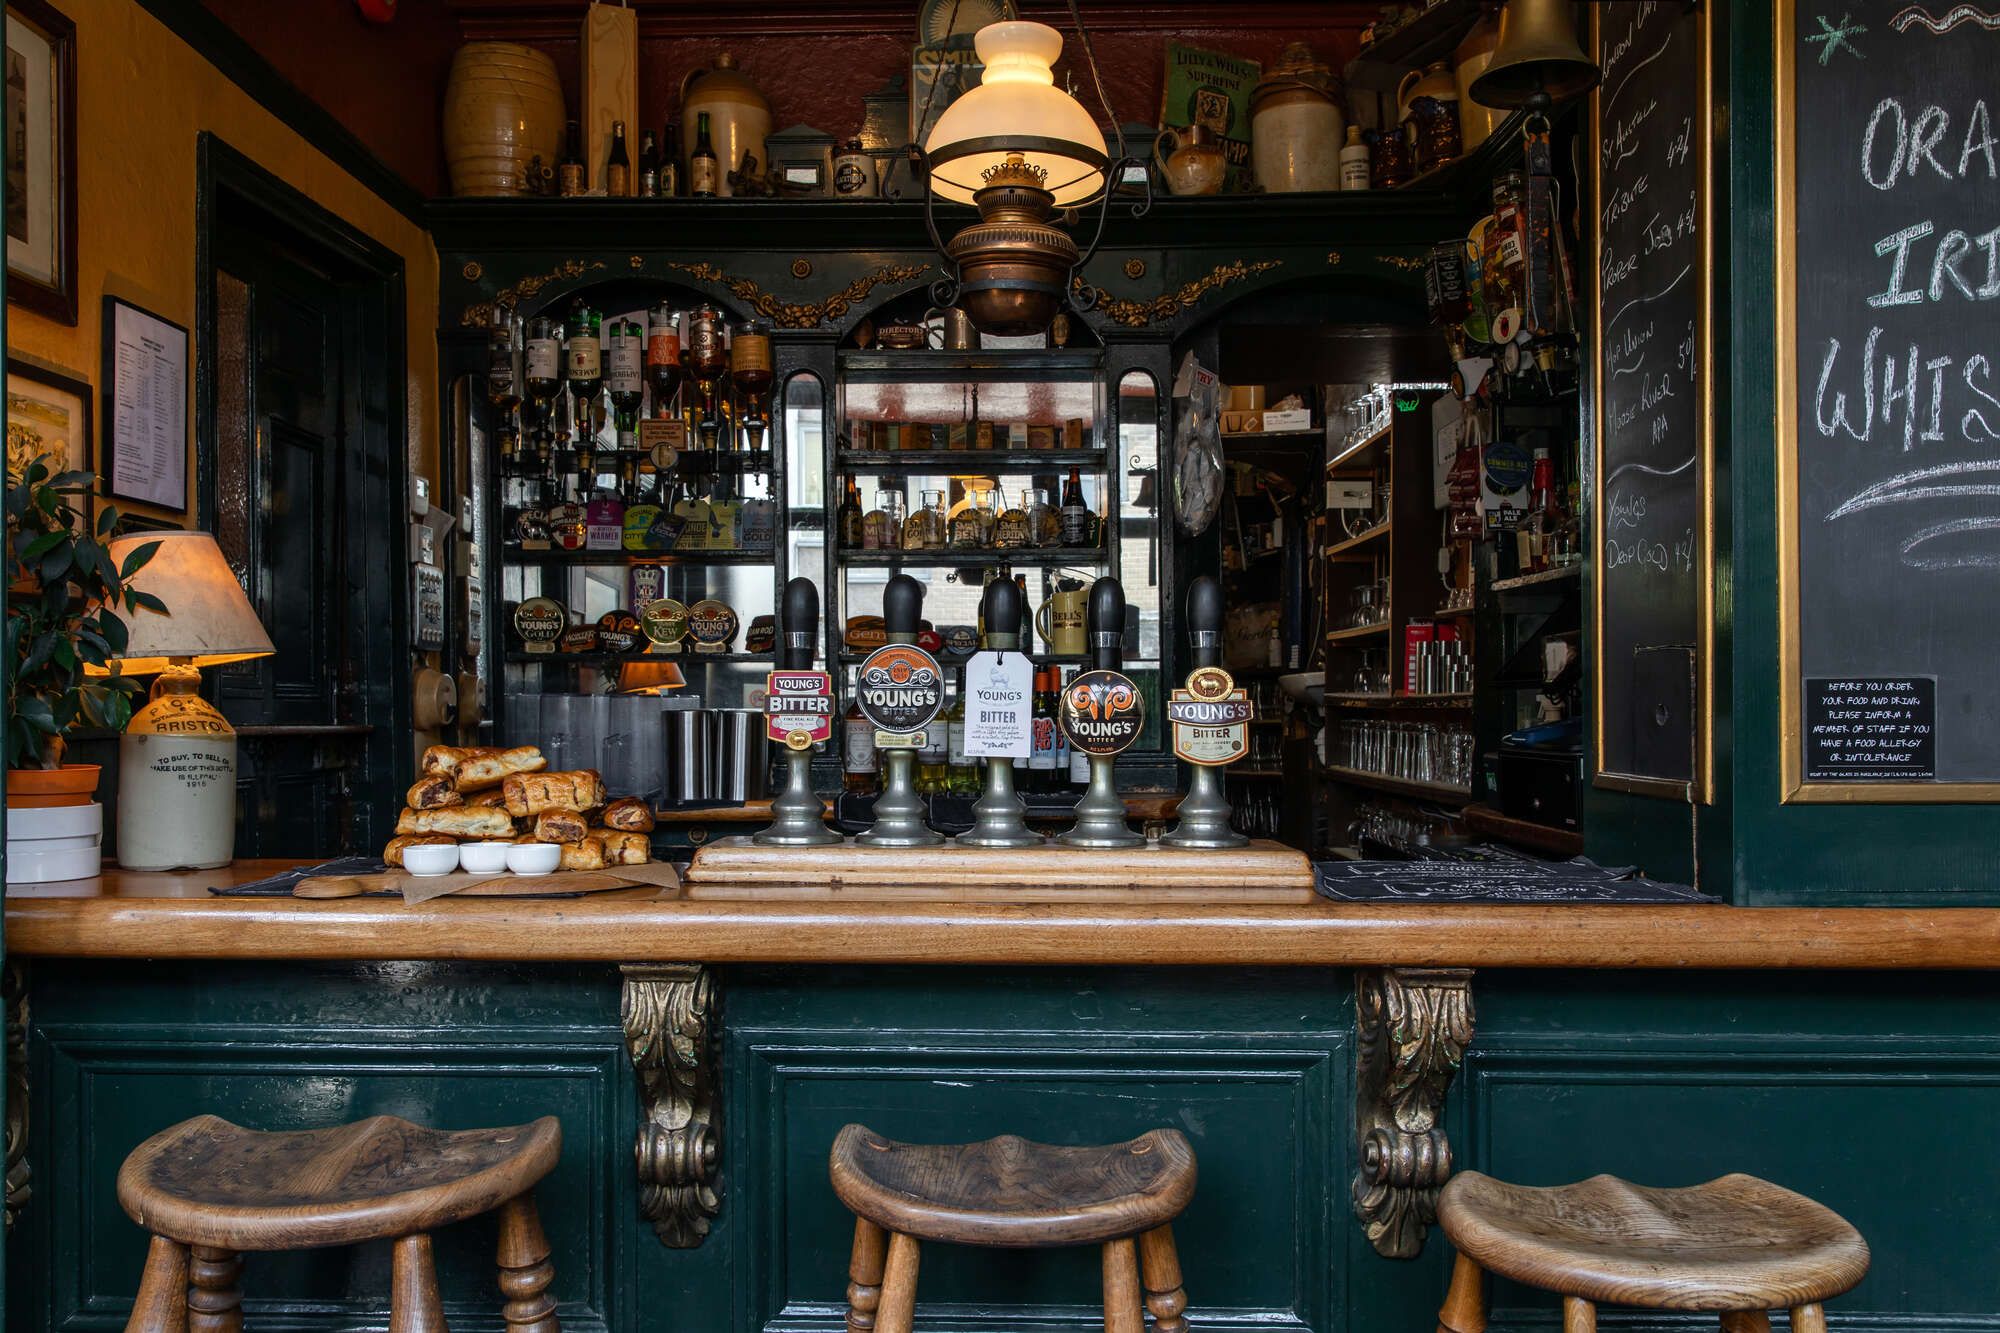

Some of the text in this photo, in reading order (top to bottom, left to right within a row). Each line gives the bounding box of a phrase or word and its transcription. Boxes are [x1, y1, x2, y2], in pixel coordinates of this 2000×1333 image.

[1602, 173, 1649, 232] TRIBUTE
[1602, 247, 1639, 293] PROPER
[1623, 320, 1654, 357] UNION
[591, 531, 619, 541] WARMER
[743, 527, 773, 535] LONDON
[744, 533, 772, 542] GOLD
[1053, 610, 1082, 621] BELL'S
[520, 621, 560, 631] YOUNG'S
[691, 621, 729, 632] YOUNG'S
[525, 630, 555, 639] GOLD
[600, 631, 632, 642] YOUNG'S
[652, 626, 678, 638] KEW
[779, 679, 820, 689] YOUNG'S
[1828, 683, 1863, 691] BEFORE
[1885, 683, 1914, 691] ORDER
[863, 689, 936, 708] YOUNG'S
[977, 689, 1022, 701] YOUNG'S
[769, 696, 829, 712] BITTER
[1822, 697, 1920, 705] YOUR FOOD AND DRINK
[882, 707, 918, 716] BITTER
[980, 711, 1016, 723] BITTER
[1174, 703, 1247, 720] YOUNG'S
[1829, 711, 1862, 719] PLEASE
[1865, 711, 1901, 719] INFORM
[156, 720, 230, 733] BRISTOL
[1072, 721, 1132, 737] YOUNG'S
[1812, 725, 1930, 733] MEMBER OF STAFF IF YOU
[1193, 728, 1230, 738] BITTER
[1820, 739, 1844, 747] HAVE
[1855, 739, 1877, 747] FOOD
[1879, 739, 1922, 747] ALLERGY
[157, 757, 169, 765] TO
[205, 753, 221, 762] SELL
[1830, 753, 1912, 761] OR INTOLERANCE
